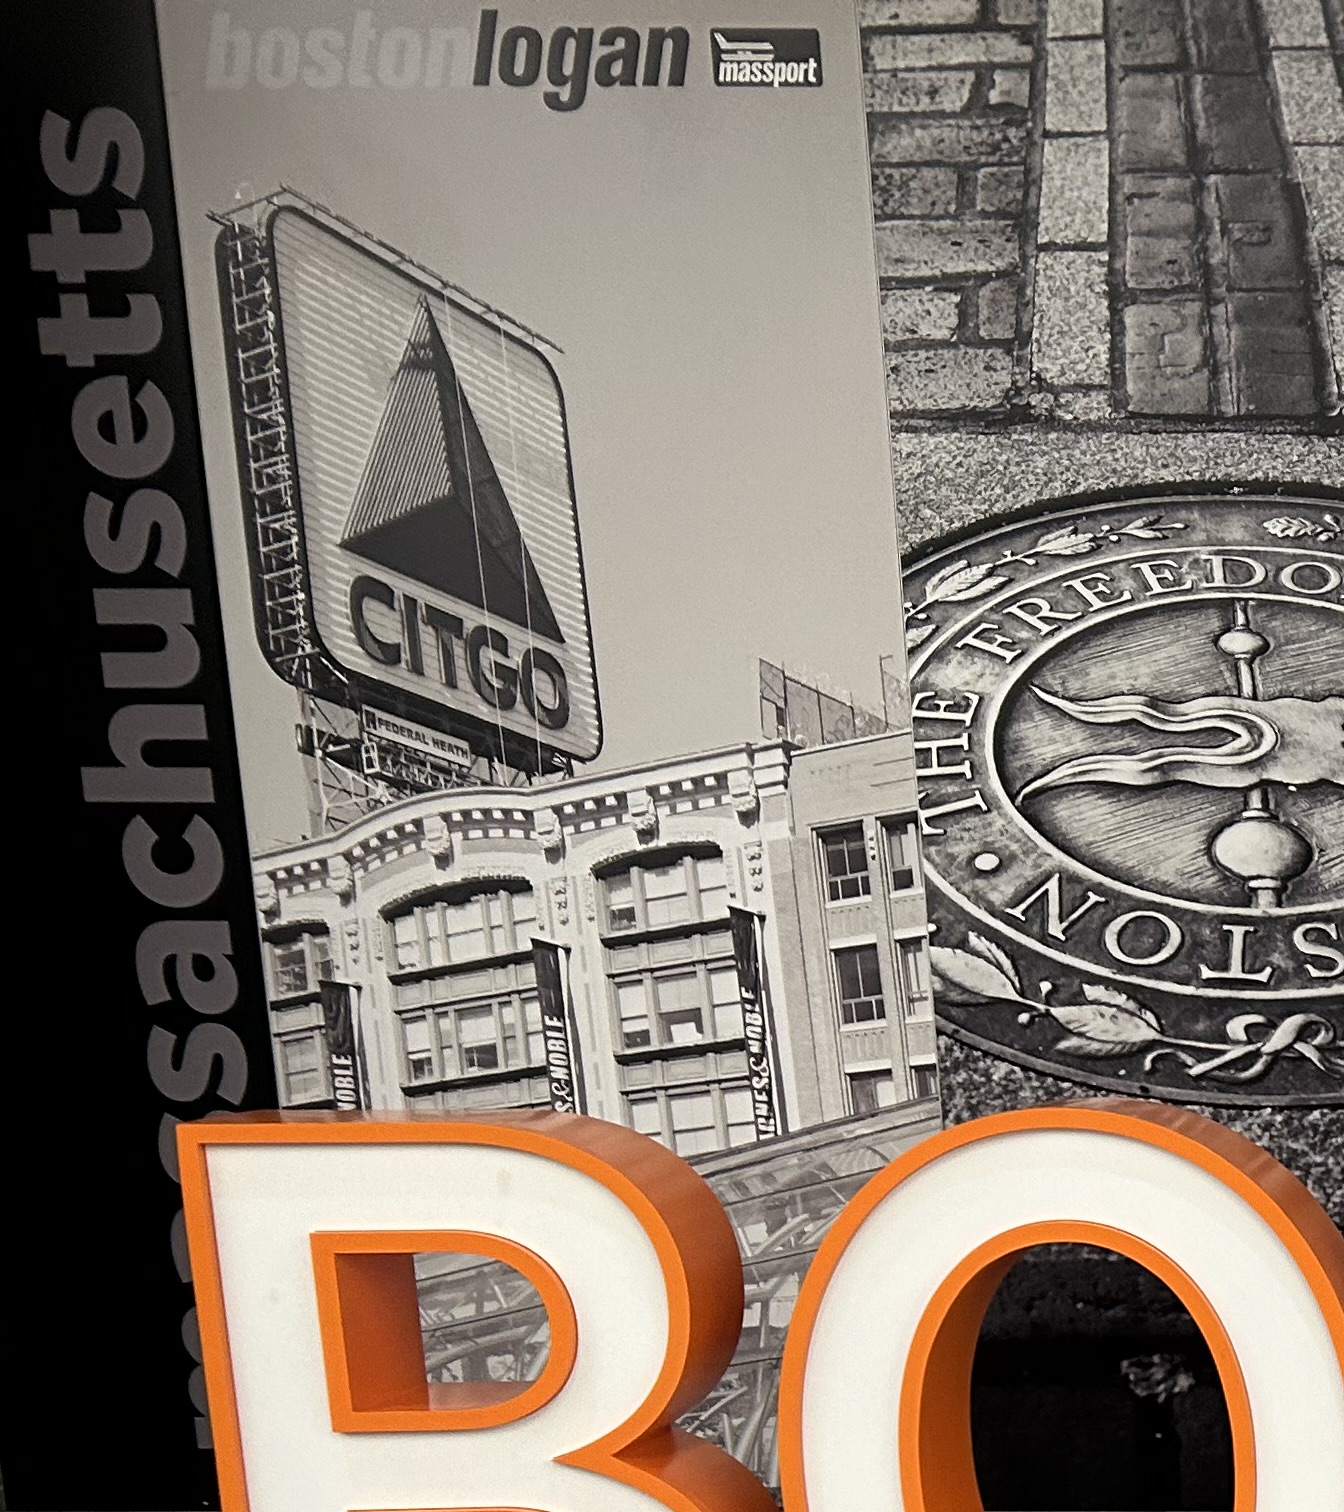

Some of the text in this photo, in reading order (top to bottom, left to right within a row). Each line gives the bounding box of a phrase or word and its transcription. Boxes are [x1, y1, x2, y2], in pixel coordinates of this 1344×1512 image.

[718, 57, 818, 87] massport
[349, 573, 571, 730] CITGO
[27, 106, 249, 1449] sachusetts
[377, 712, 470, 761] FEDERAL HEATH
[911, 690, 986, 837] THE
